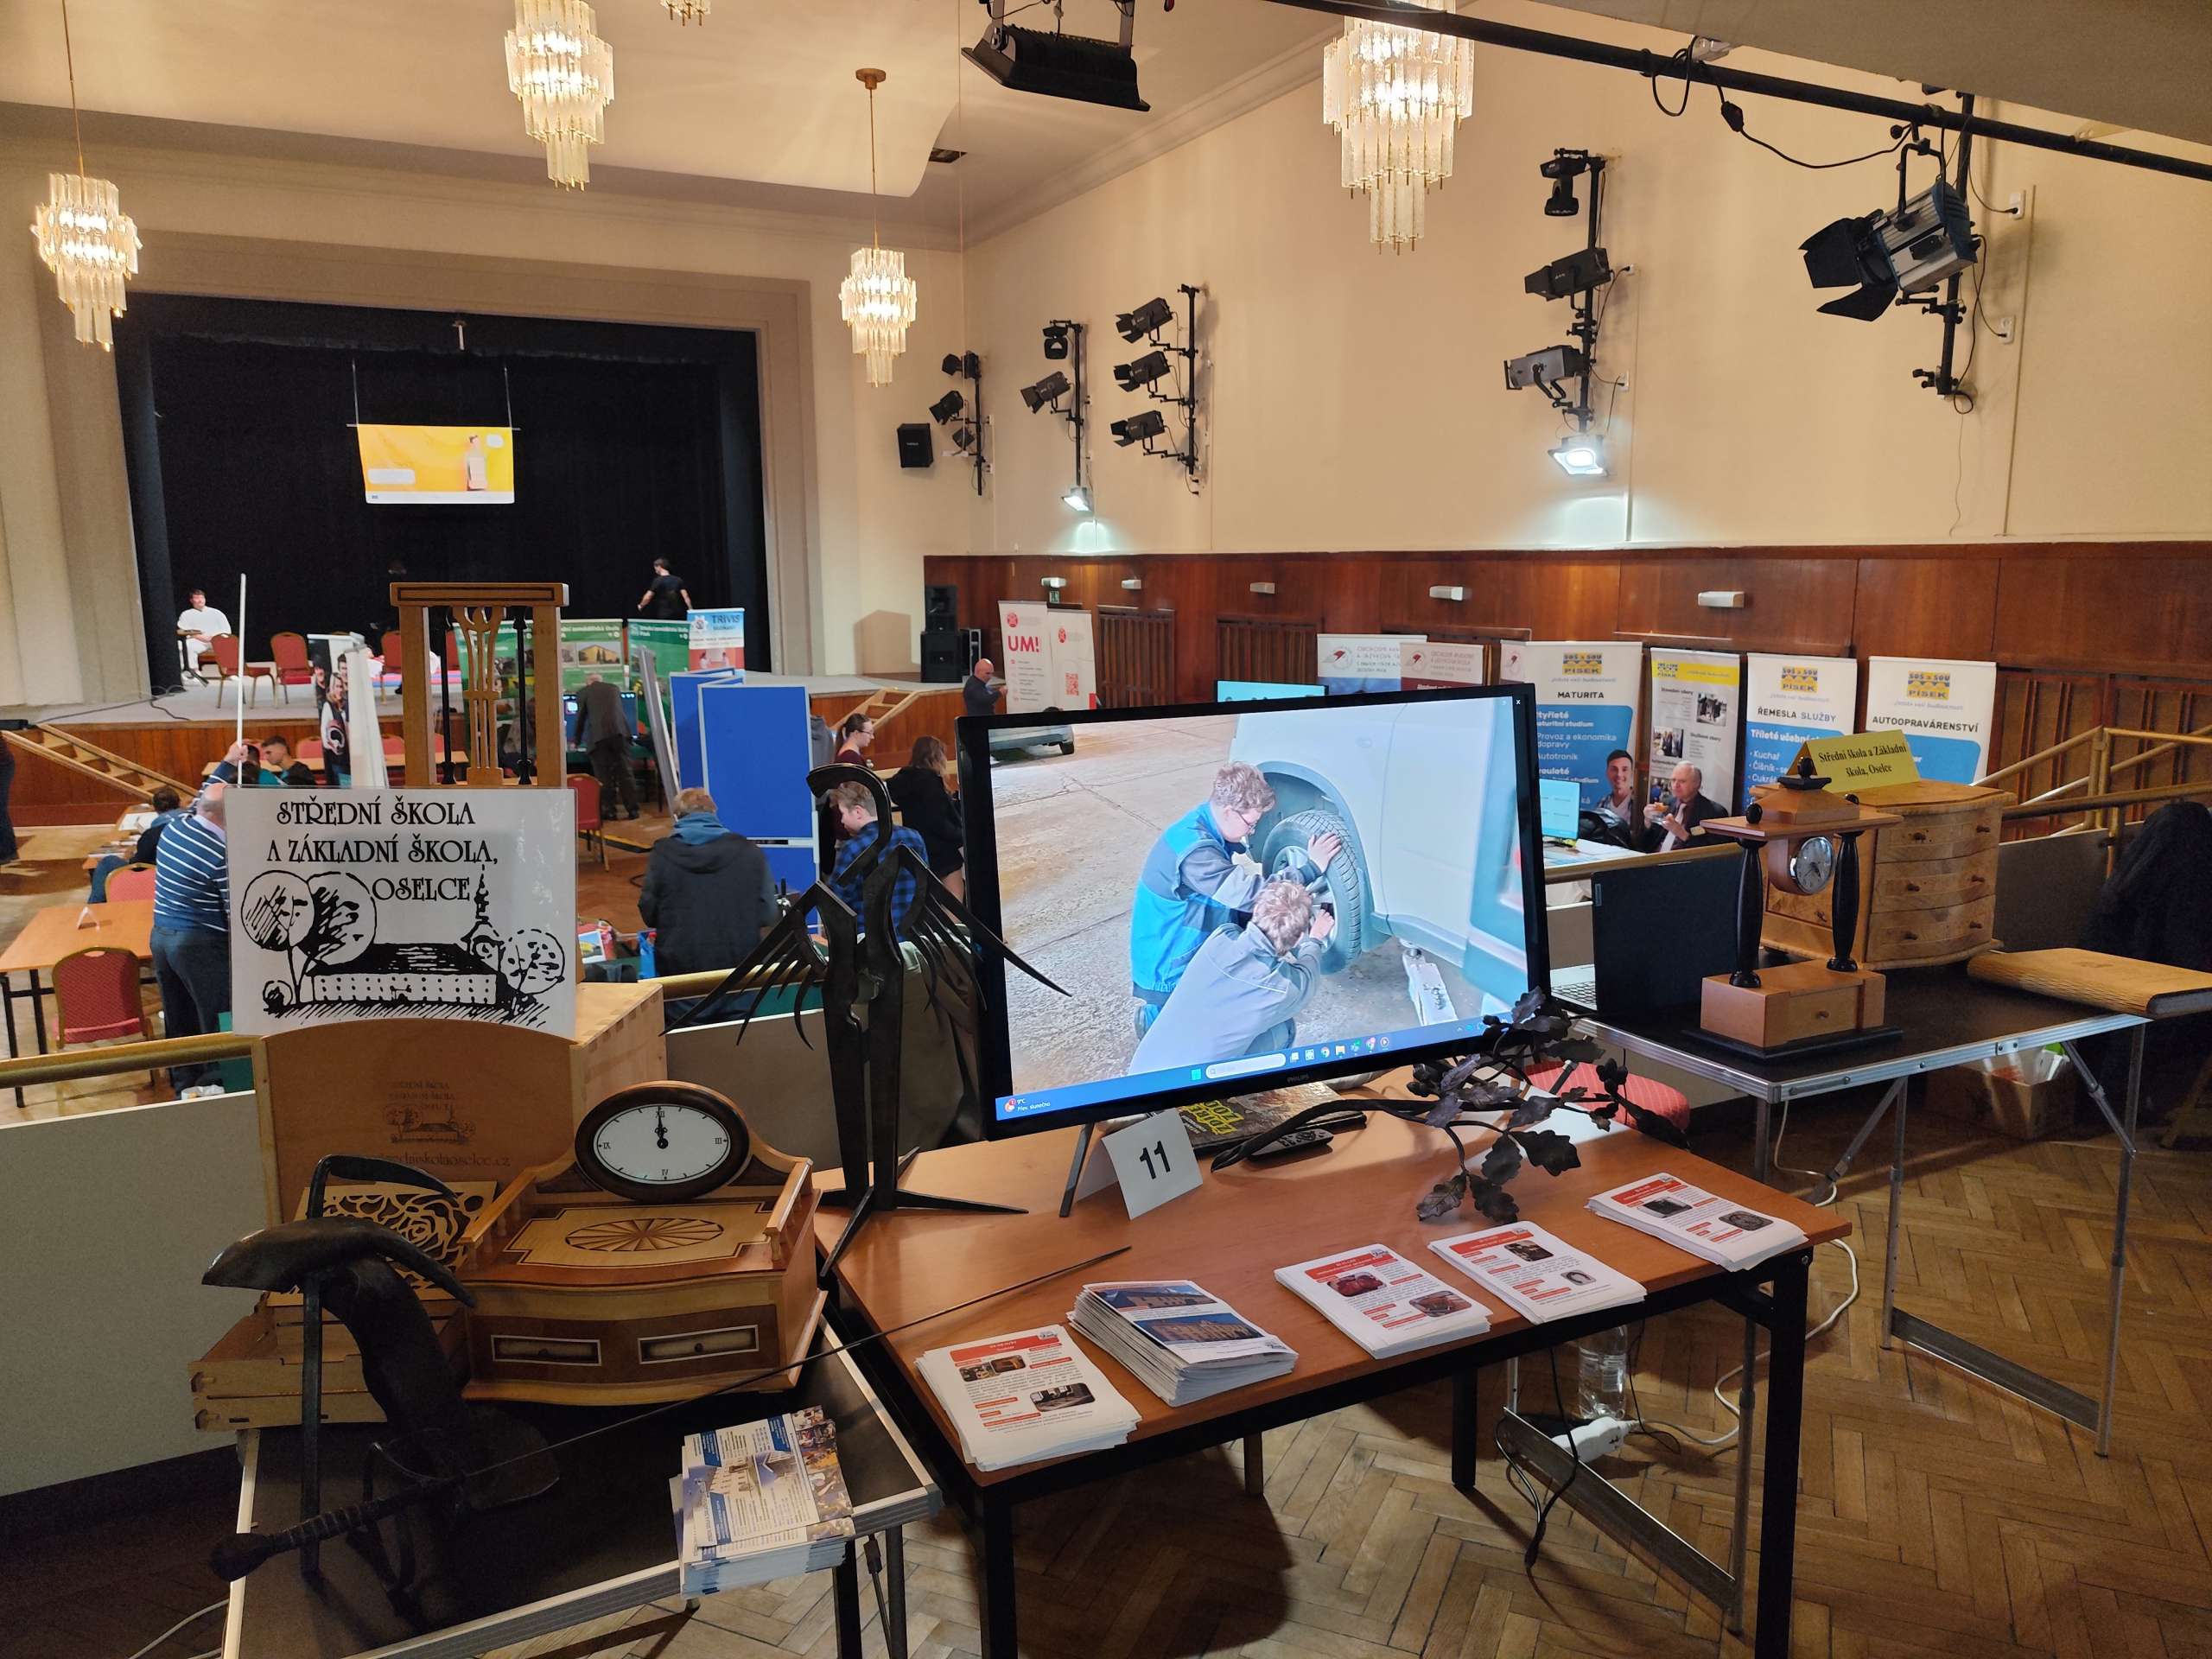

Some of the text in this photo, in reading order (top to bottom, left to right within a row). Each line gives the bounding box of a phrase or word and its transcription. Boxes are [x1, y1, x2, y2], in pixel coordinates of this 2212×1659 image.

[712, 614, 740, 624] TRIVIS
[1007, 635, 1039, 652] UM!
[1536, 711, 1569, 720] tyřleté
[1758, 706, 1837, 723] ŘEMESLA SLUŽBY
[1872, 716, 1979, 733] AUTOOPRAVÁRENSTVÍ
[1819, 750, 1847, 762] Střední
[1847, 748, 1867, 760] škola
[1873, 744, 1907, 754] Základní
[1869, 763, 1892, 774] Oselce
[1752, 773, 1778, 784] Cukrá
[276, 795, 476, 825] STŘEDNÍ ŠKOLA
[267, 833, 499, 865] A ZÁKLADNÍ ŠKOLA,
[372, 878, 471, 900] OSELCE
[1140, 1141, 1170, 1179] 11
